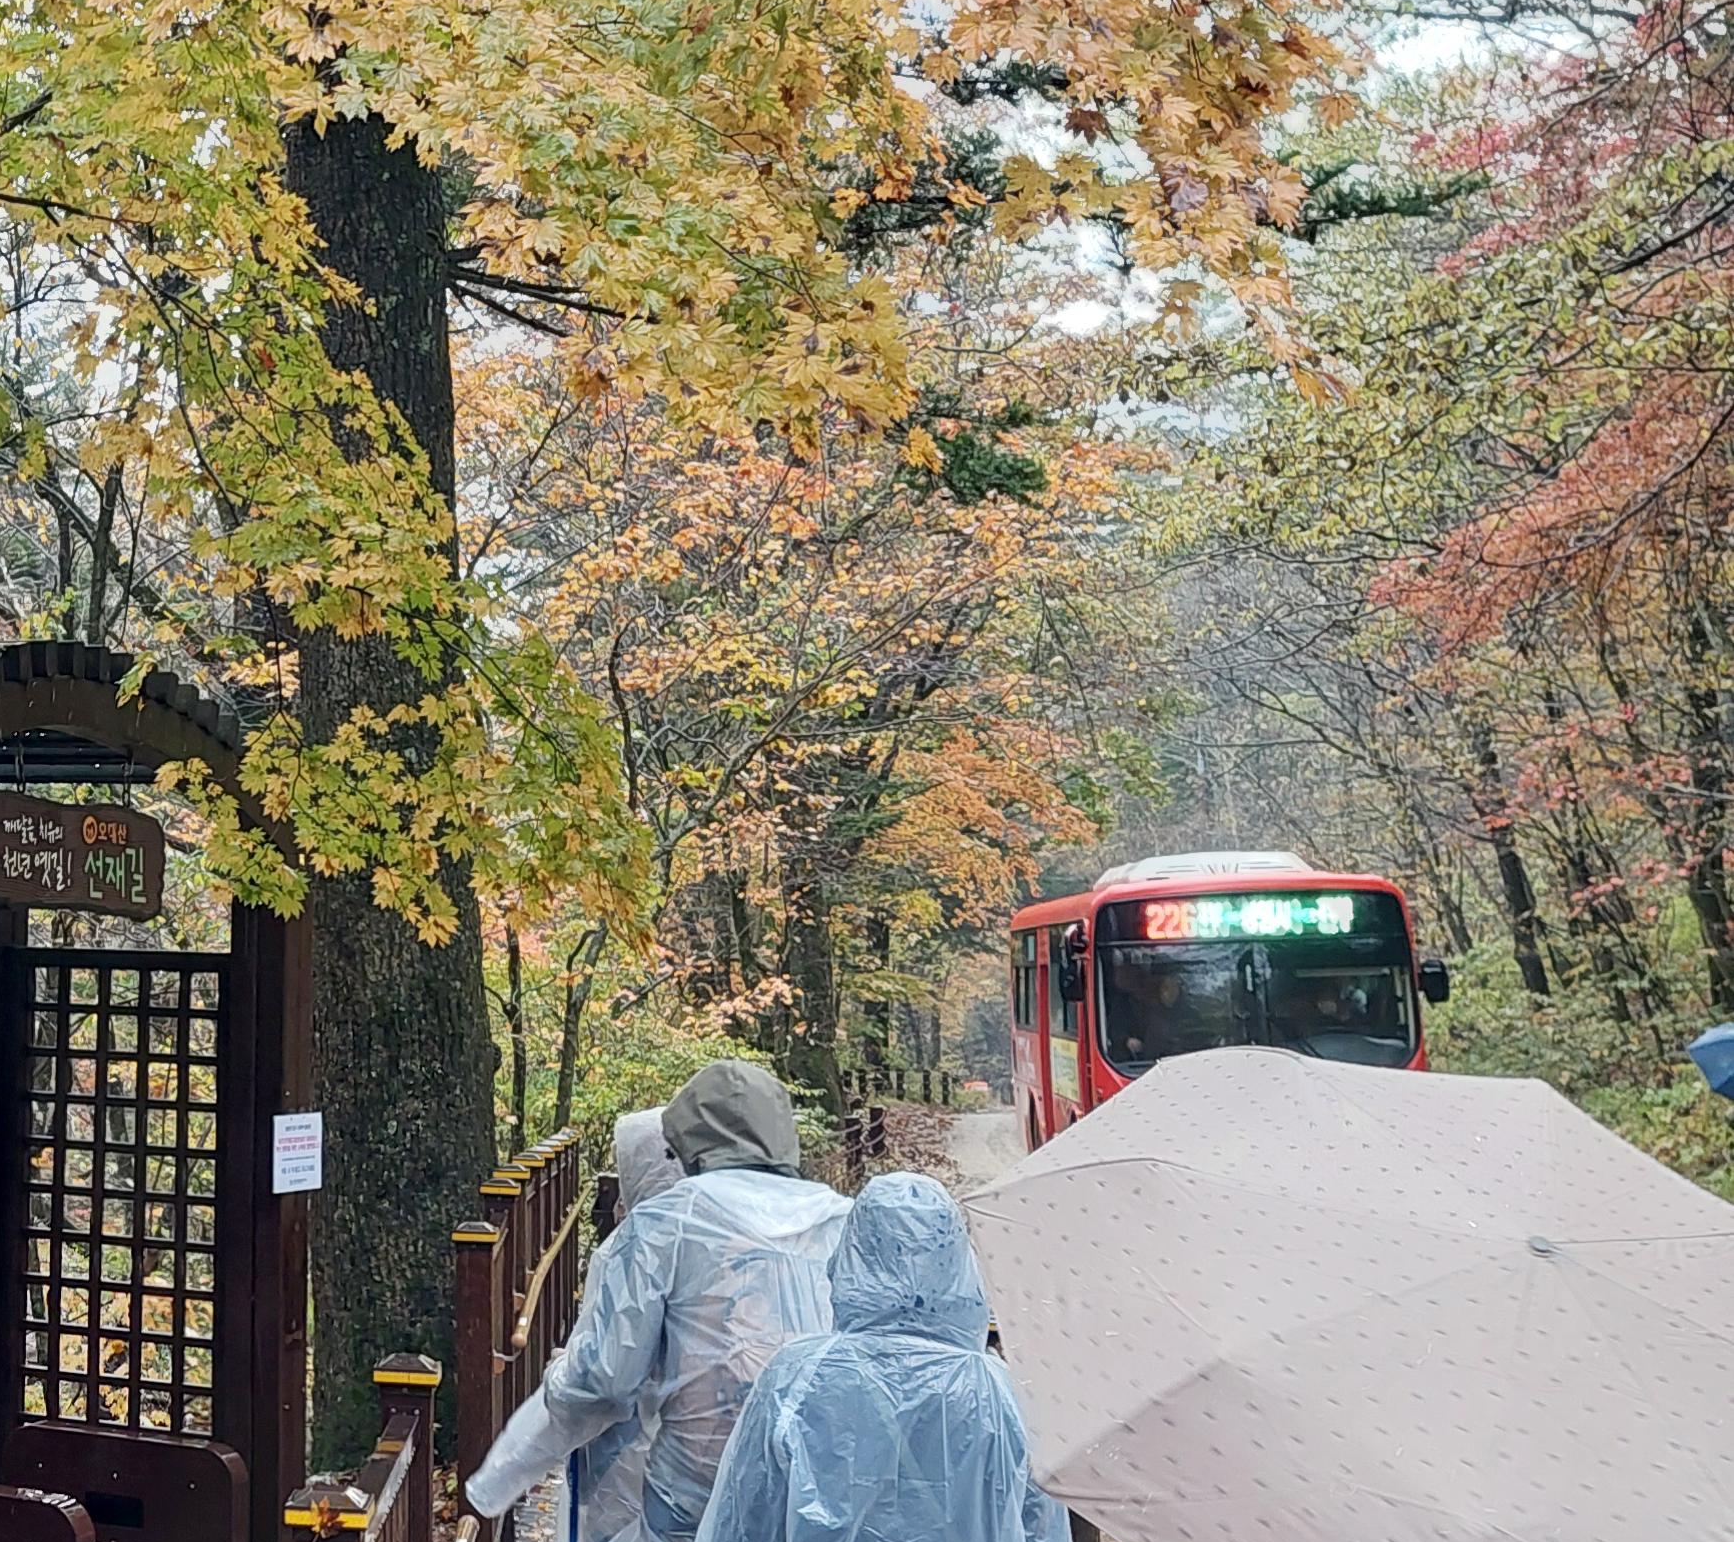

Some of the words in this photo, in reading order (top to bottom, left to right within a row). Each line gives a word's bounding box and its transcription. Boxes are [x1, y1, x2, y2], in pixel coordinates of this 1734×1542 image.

[39, 816, 64, 844] 치유의
[97, 821, 127, 845] 오대산
[2, 846, 33, 880] 천년
[84, 846, 147, 903] 선재길
